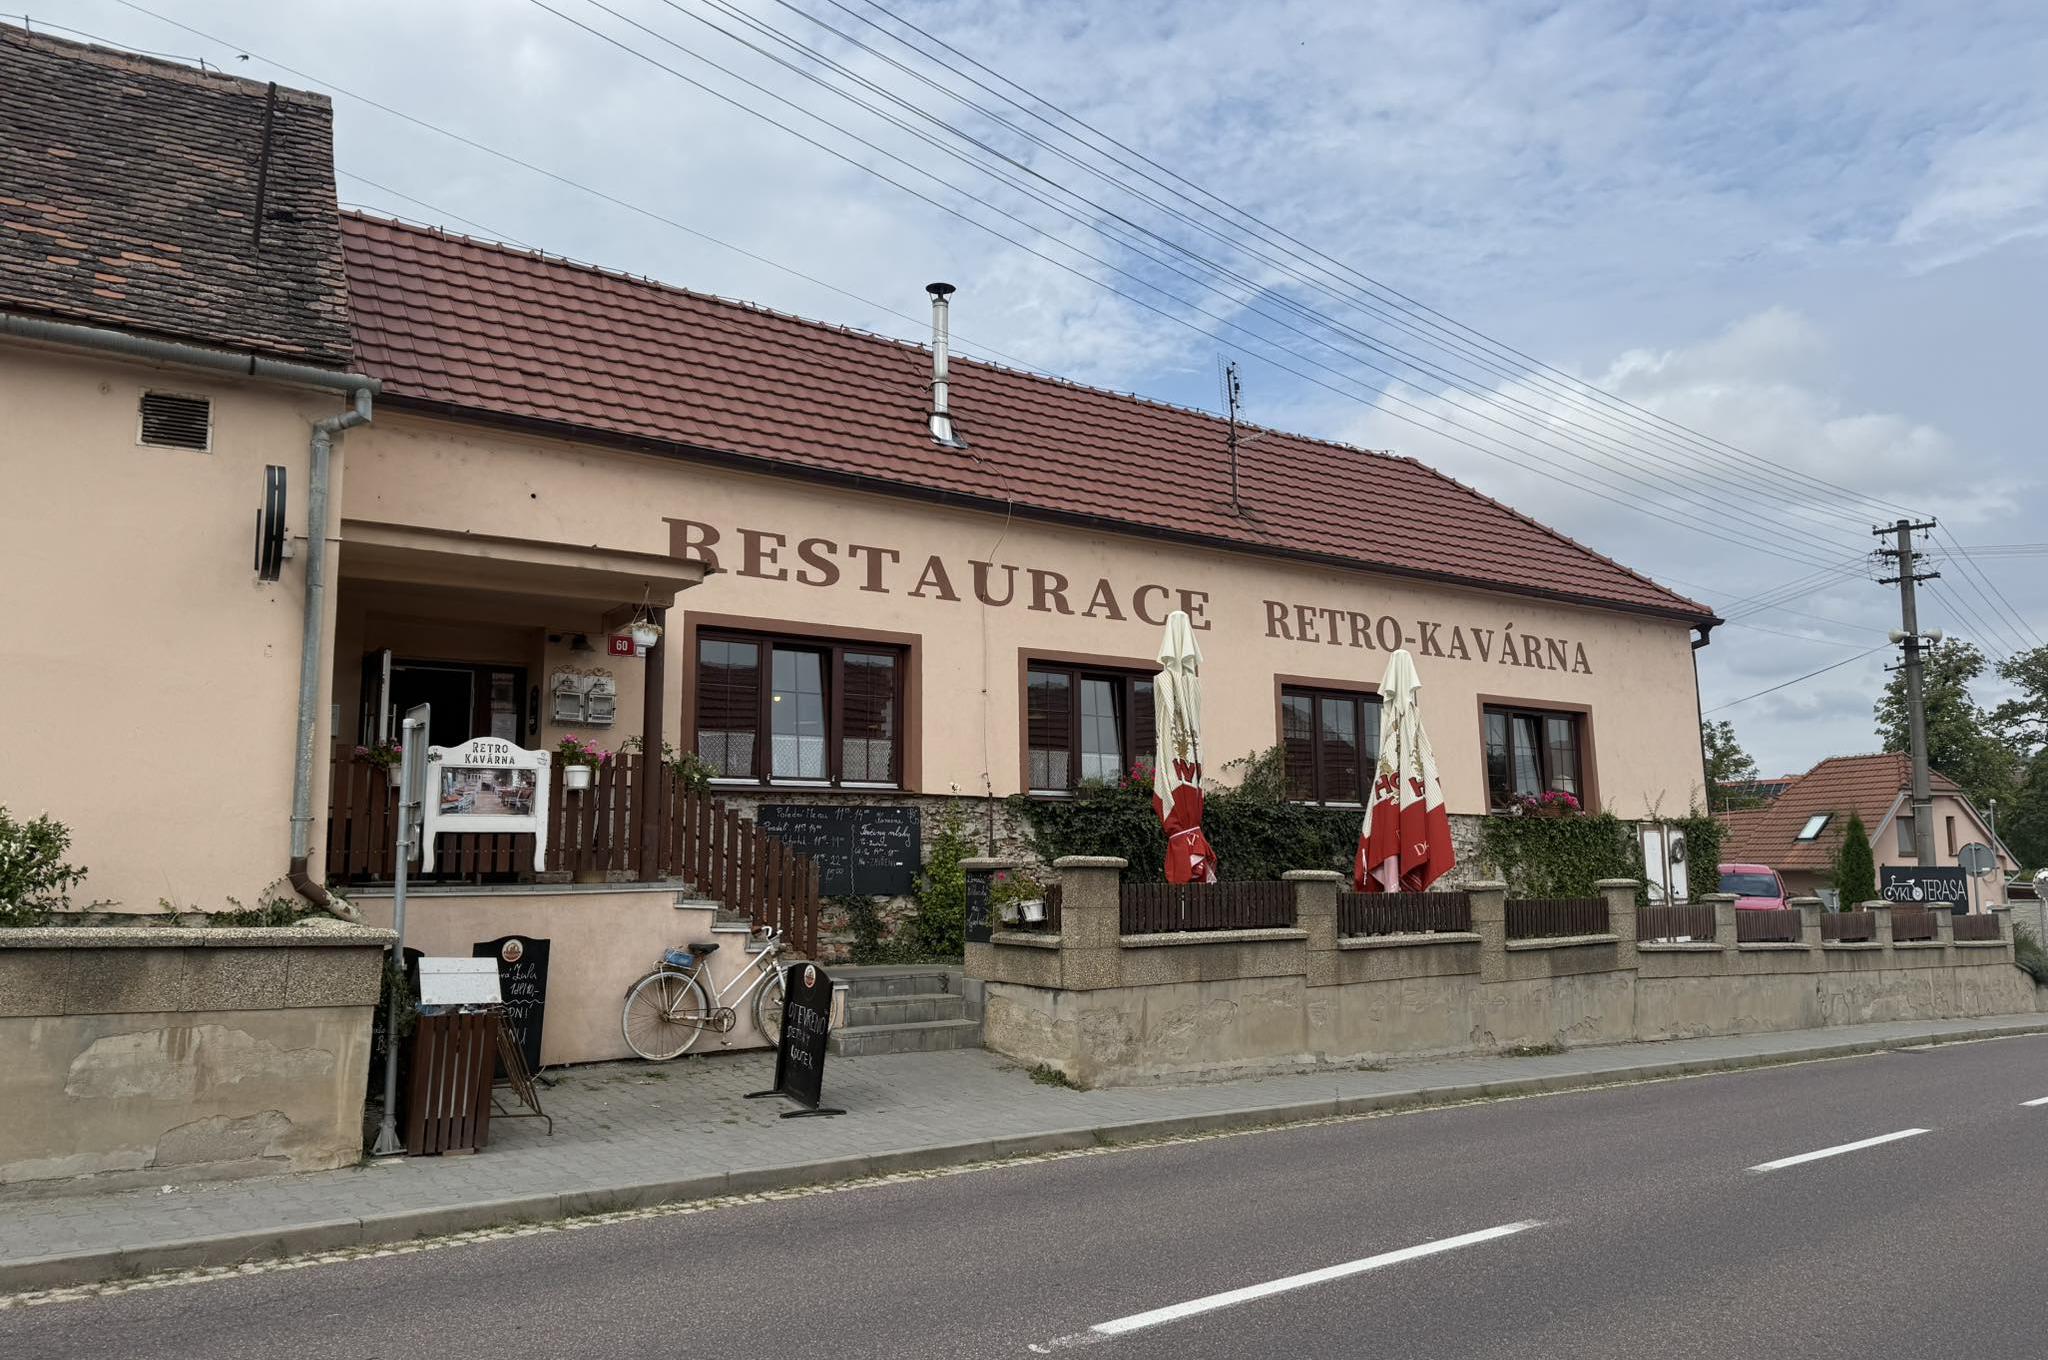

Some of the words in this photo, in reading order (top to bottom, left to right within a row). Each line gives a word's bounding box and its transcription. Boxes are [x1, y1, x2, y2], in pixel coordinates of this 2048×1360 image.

[662, 516, 1211, 631] RESTAURACE
[1263, 600, 1593, 675] RETRO-KAVÁRNA
[616, 640, 628, 652] 60
[473, 742, 509, 754] RETRO
[465, 754, 516, 765] KAVÁRNA
